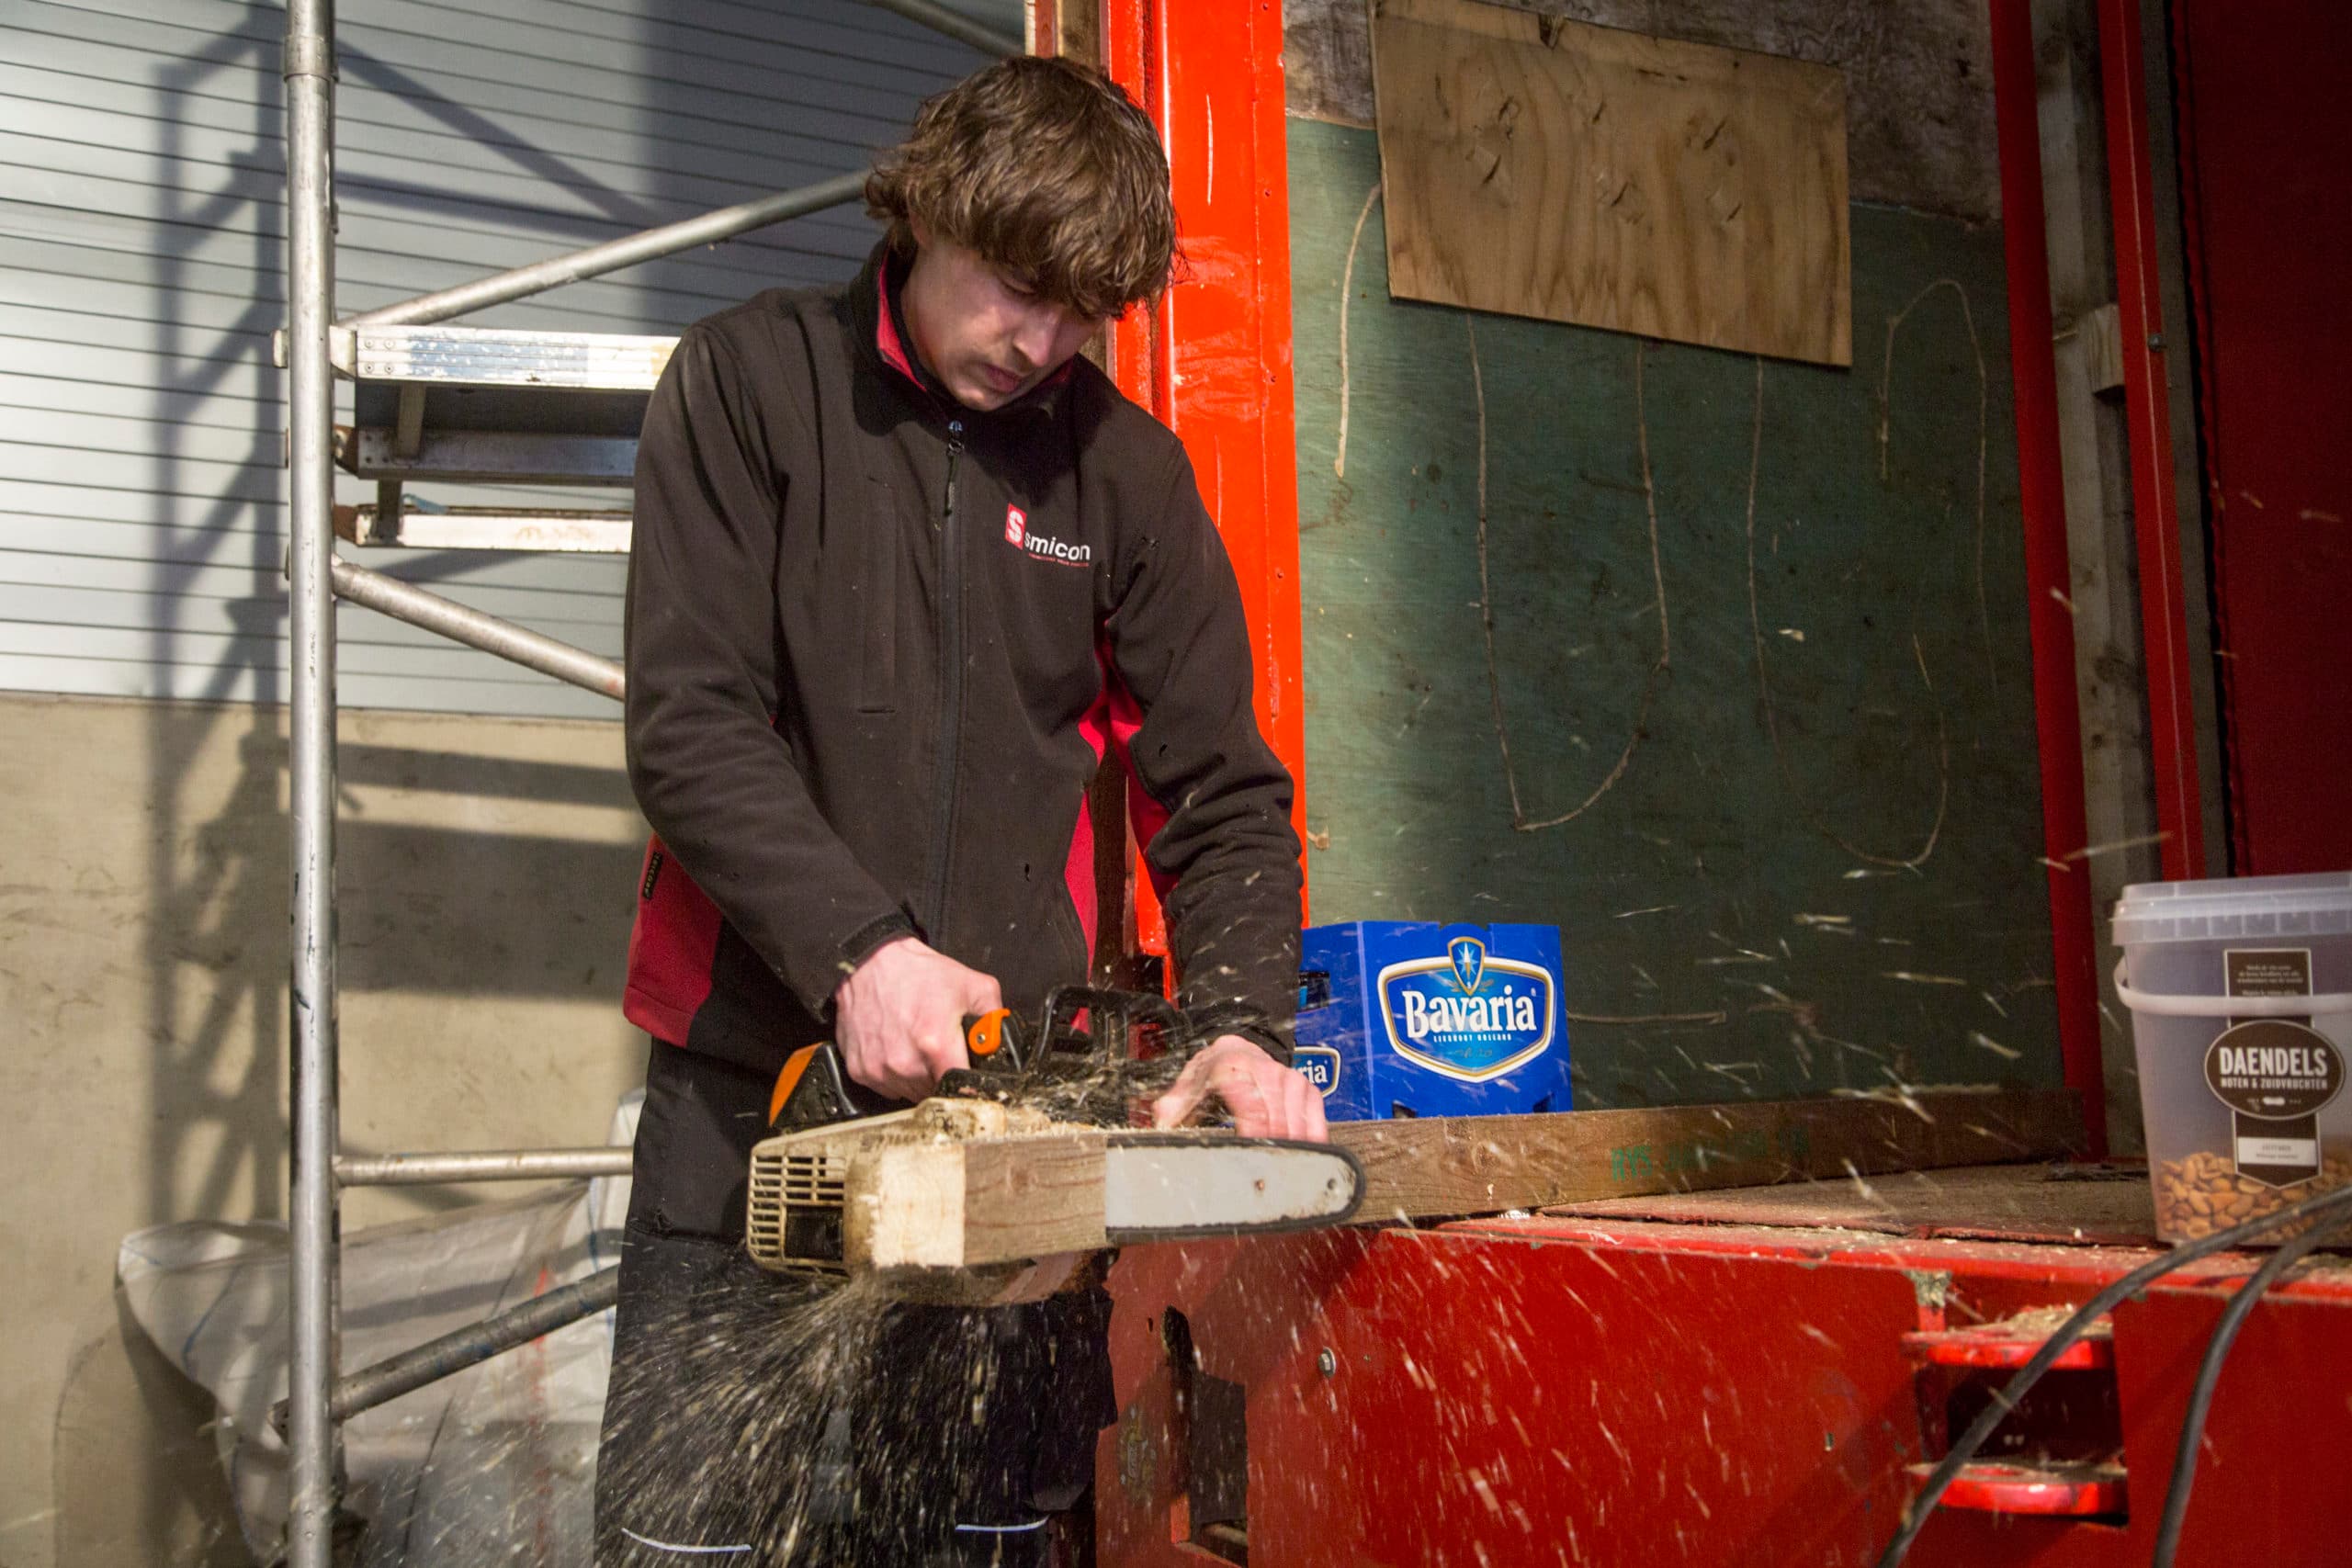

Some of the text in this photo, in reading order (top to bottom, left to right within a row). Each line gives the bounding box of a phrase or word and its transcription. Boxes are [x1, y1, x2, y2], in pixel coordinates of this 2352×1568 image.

[1024, 532, 1091, 560] smicon
[1401, 985, 1537, 1039] Bavaria
[2219, 1047, 2328, 1077] DAENDELS
